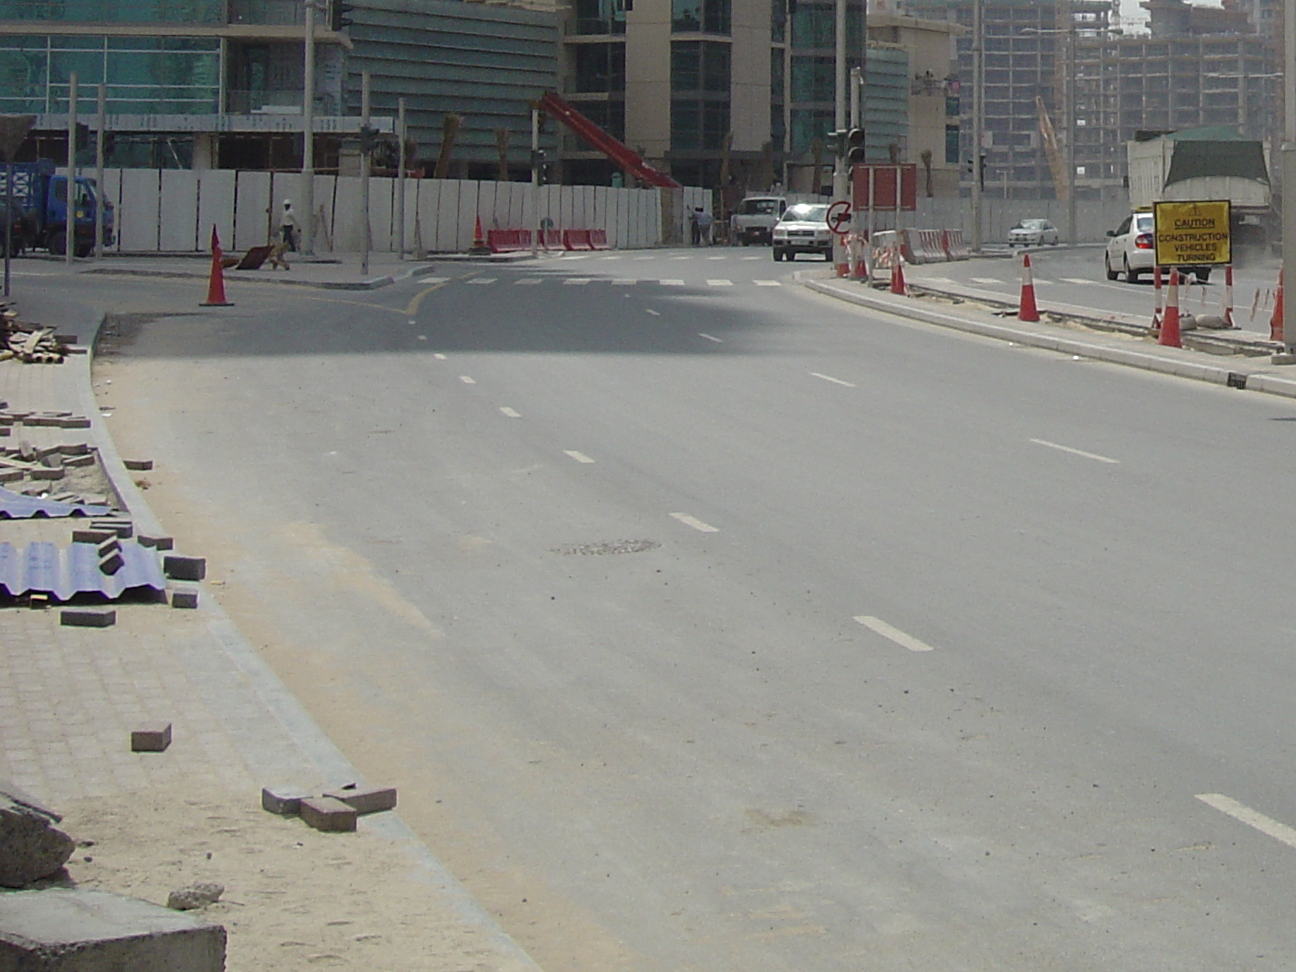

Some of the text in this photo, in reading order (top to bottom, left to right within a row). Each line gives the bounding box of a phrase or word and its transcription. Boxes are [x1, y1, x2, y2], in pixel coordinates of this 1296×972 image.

[1174, 218, 1215, 227] CAUTION
[1158, 232, 1228, 243] CONSTRUCTION
[1174, 242, 1217, 252] VEHICLES
[1177, 253, 1216, 261] TURNING
